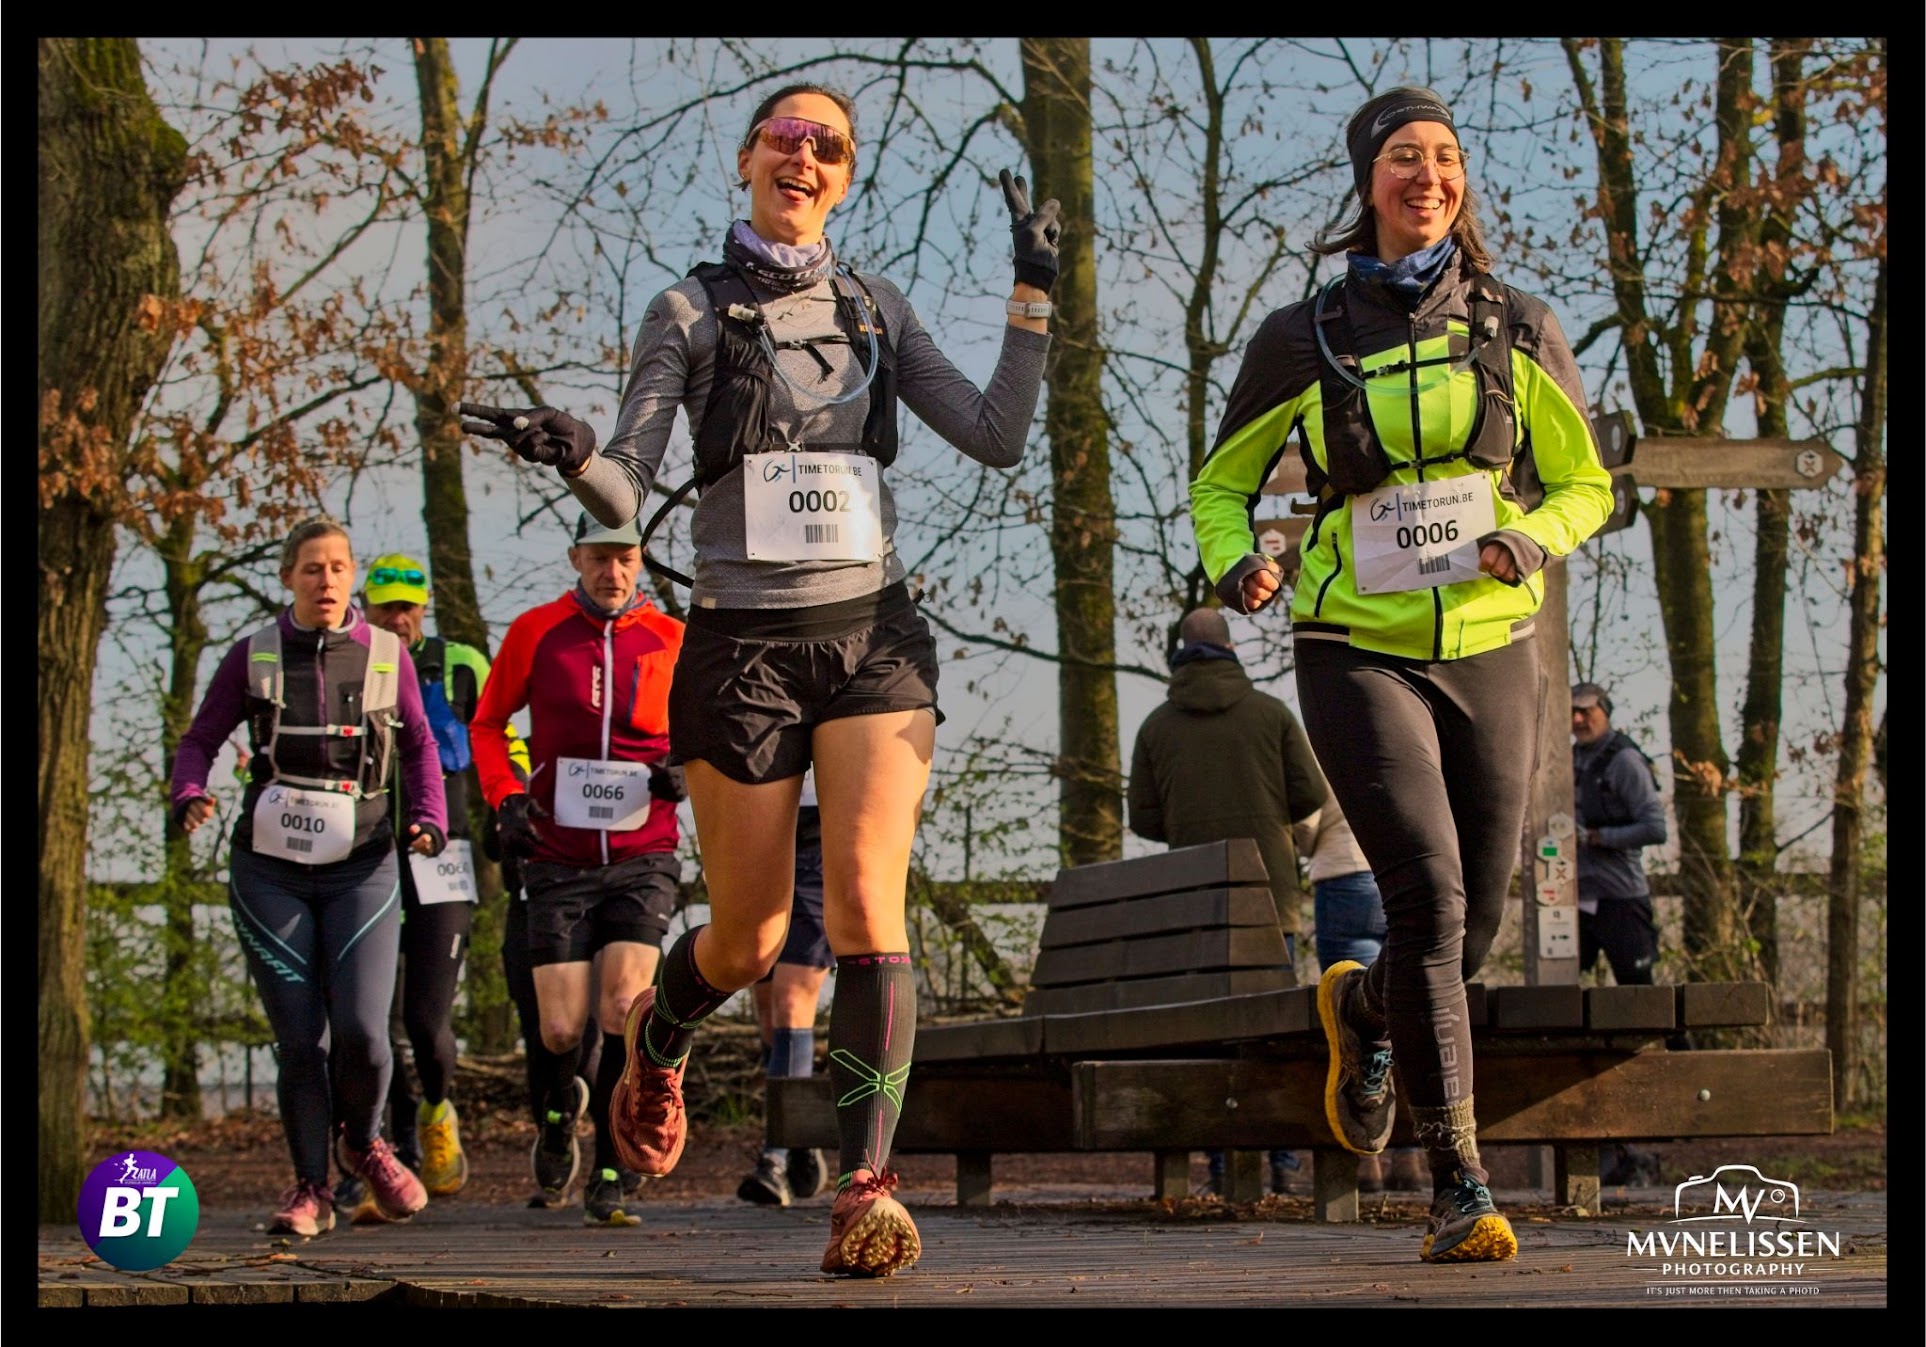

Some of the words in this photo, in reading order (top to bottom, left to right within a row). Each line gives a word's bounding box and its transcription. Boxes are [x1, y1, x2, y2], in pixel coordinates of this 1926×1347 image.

[798, 464, 862, 476] TIMETORUNBE
[789, 490, 850, 513] 0002
[1402, 492, 1473, 512] TIMETORUN.BE
[1396, 519, 1459, 549] 0006
[582, 783, 624, 801] 0066
[281, 813, 325, 834] 0010
[1431, 1007, 1460, 1104] alenji
